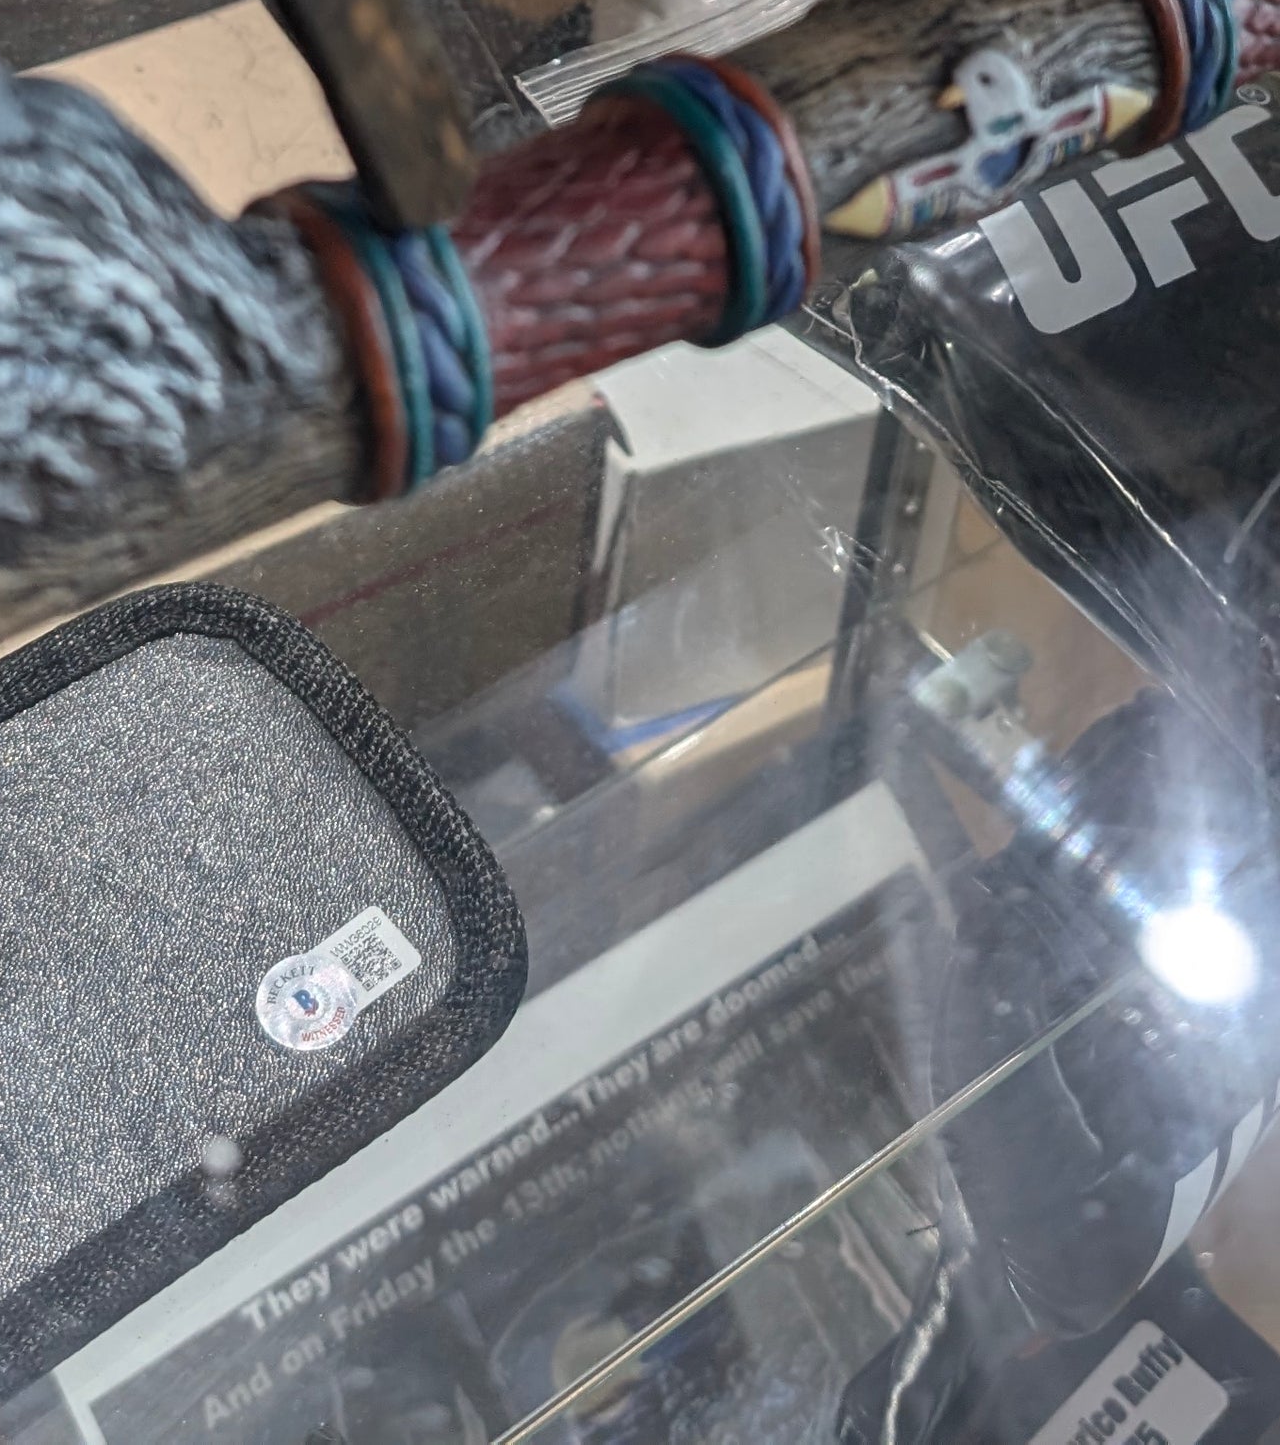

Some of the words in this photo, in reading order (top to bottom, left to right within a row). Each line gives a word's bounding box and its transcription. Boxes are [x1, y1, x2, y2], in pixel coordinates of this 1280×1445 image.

[266, 964, 317, 1005] BECKETT
[300, 1006, 347, 1043] WITNESSED
[241, 1260, 332, 1333] They
[336, 1203, 425, 1271] were
[650, 1018, 702, 1061] are
[201, 1362, 273, 1429] And
[280, 1334, 326, 1376] on
[327, 1259, 437, 1340] Friday
[438, 1217, 497, 1266] the
